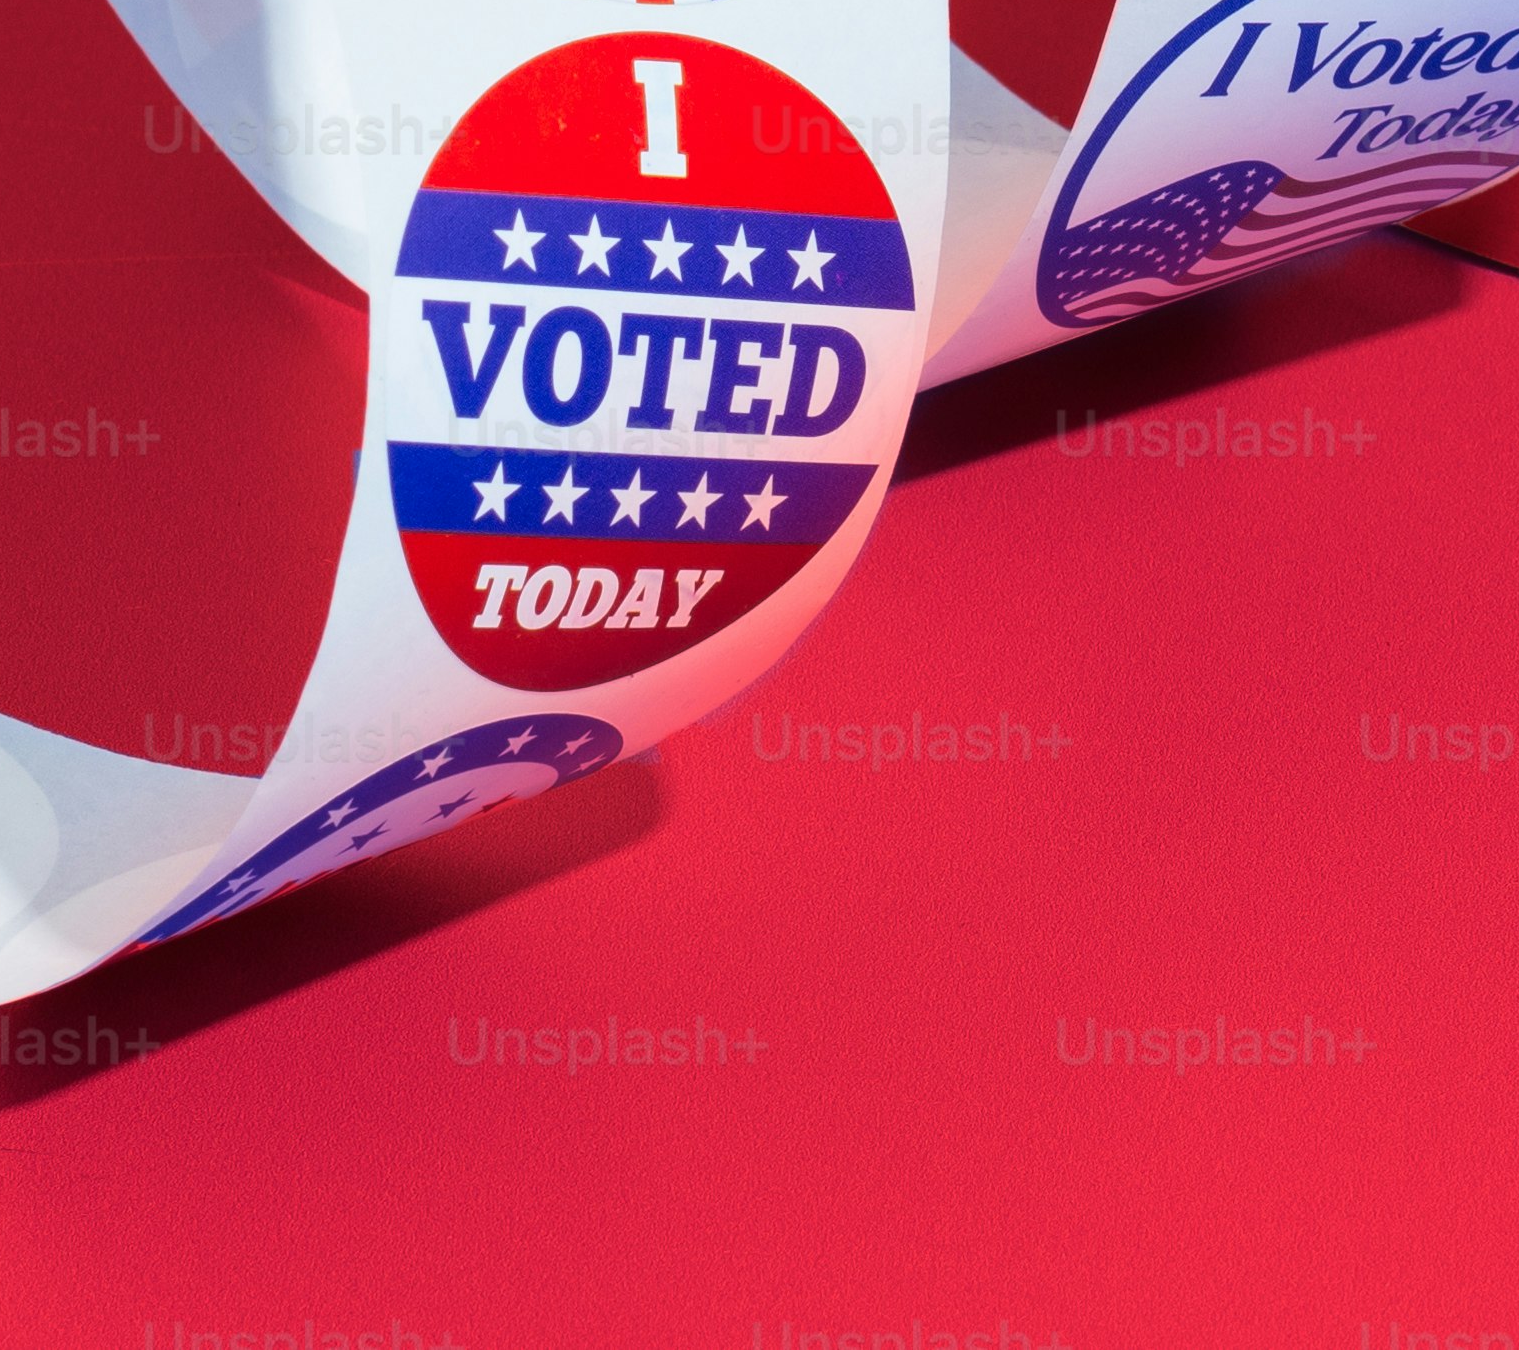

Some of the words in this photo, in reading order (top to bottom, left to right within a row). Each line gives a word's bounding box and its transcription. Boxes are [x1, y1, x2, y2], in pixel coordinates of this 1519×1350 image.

[1202, 22, 1270, 96] I
[632, 59, 688, 177] I
[421, 300, 867, 438] VOTED
[472, 563, 722, 628] TODAY
